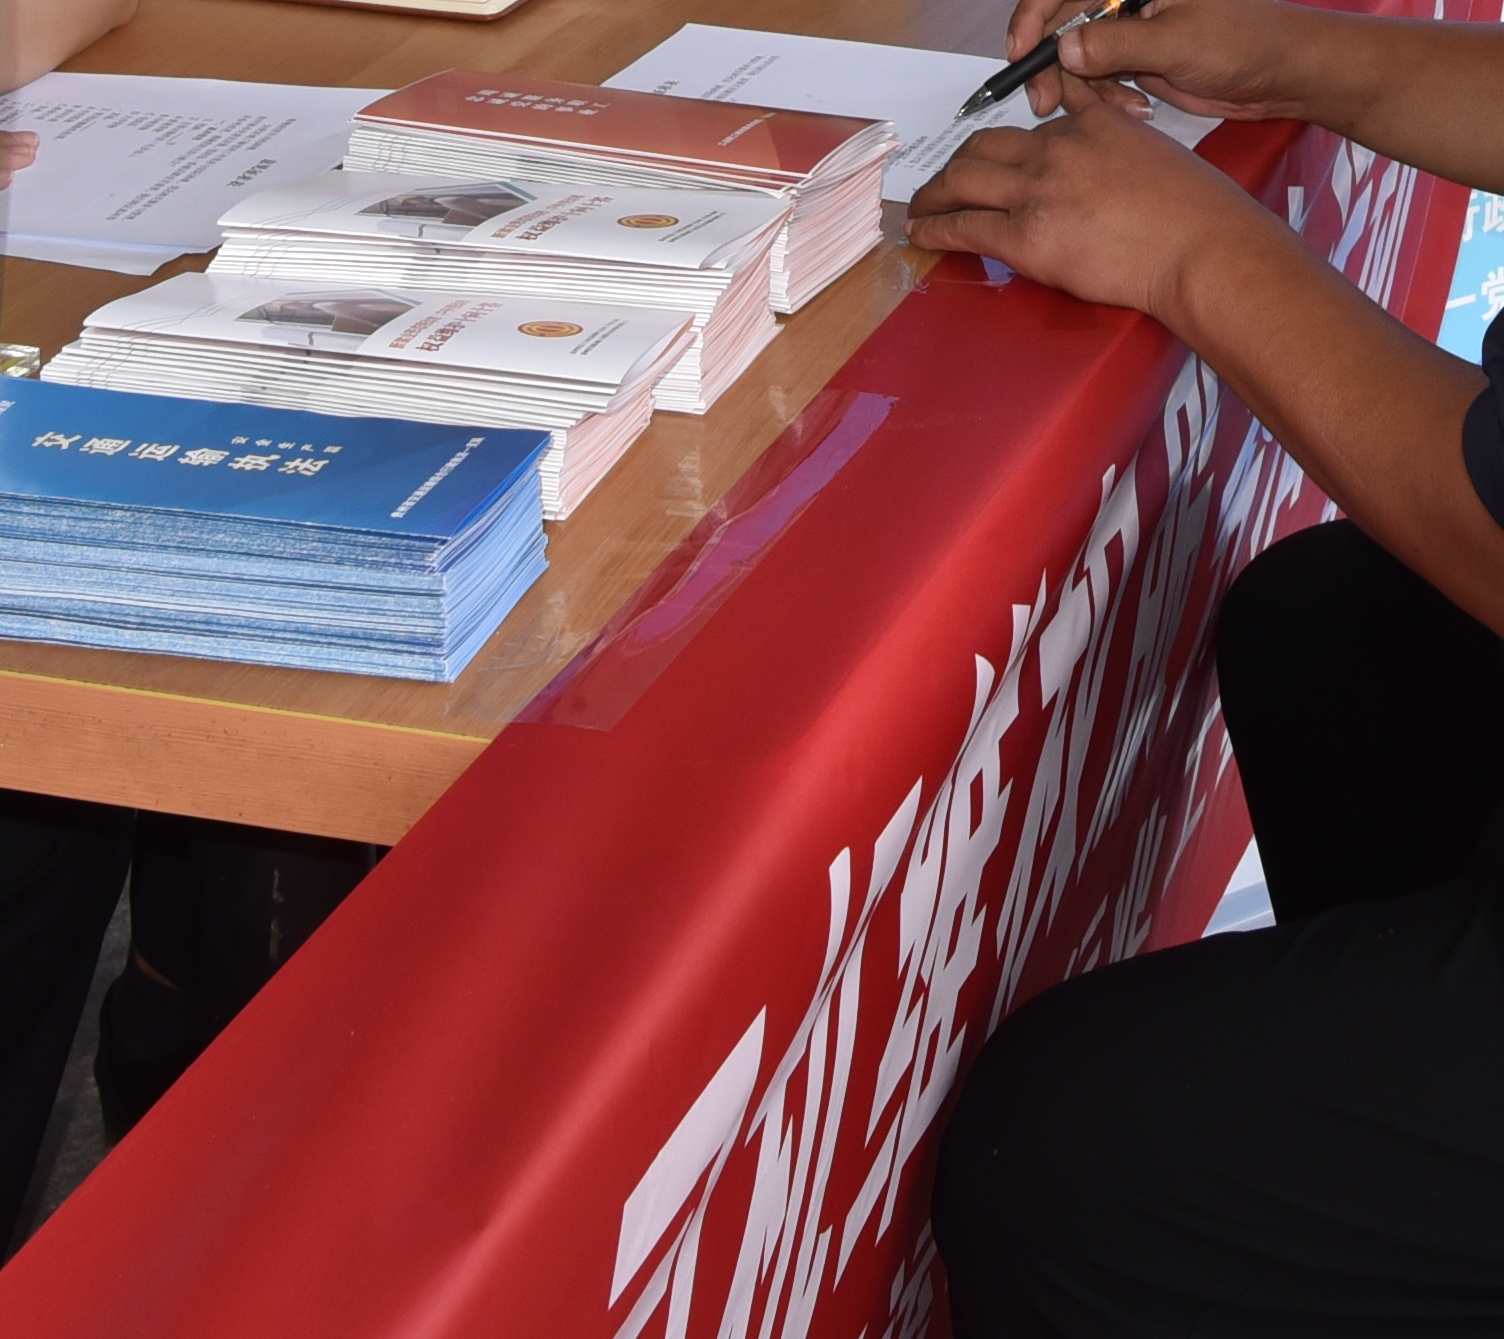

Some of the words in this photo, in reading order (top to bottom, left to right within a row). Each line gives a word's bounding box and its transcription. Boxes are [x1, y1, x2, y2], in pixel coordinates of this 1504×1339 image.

[31, 430, 331, 478] 交通运输执法
